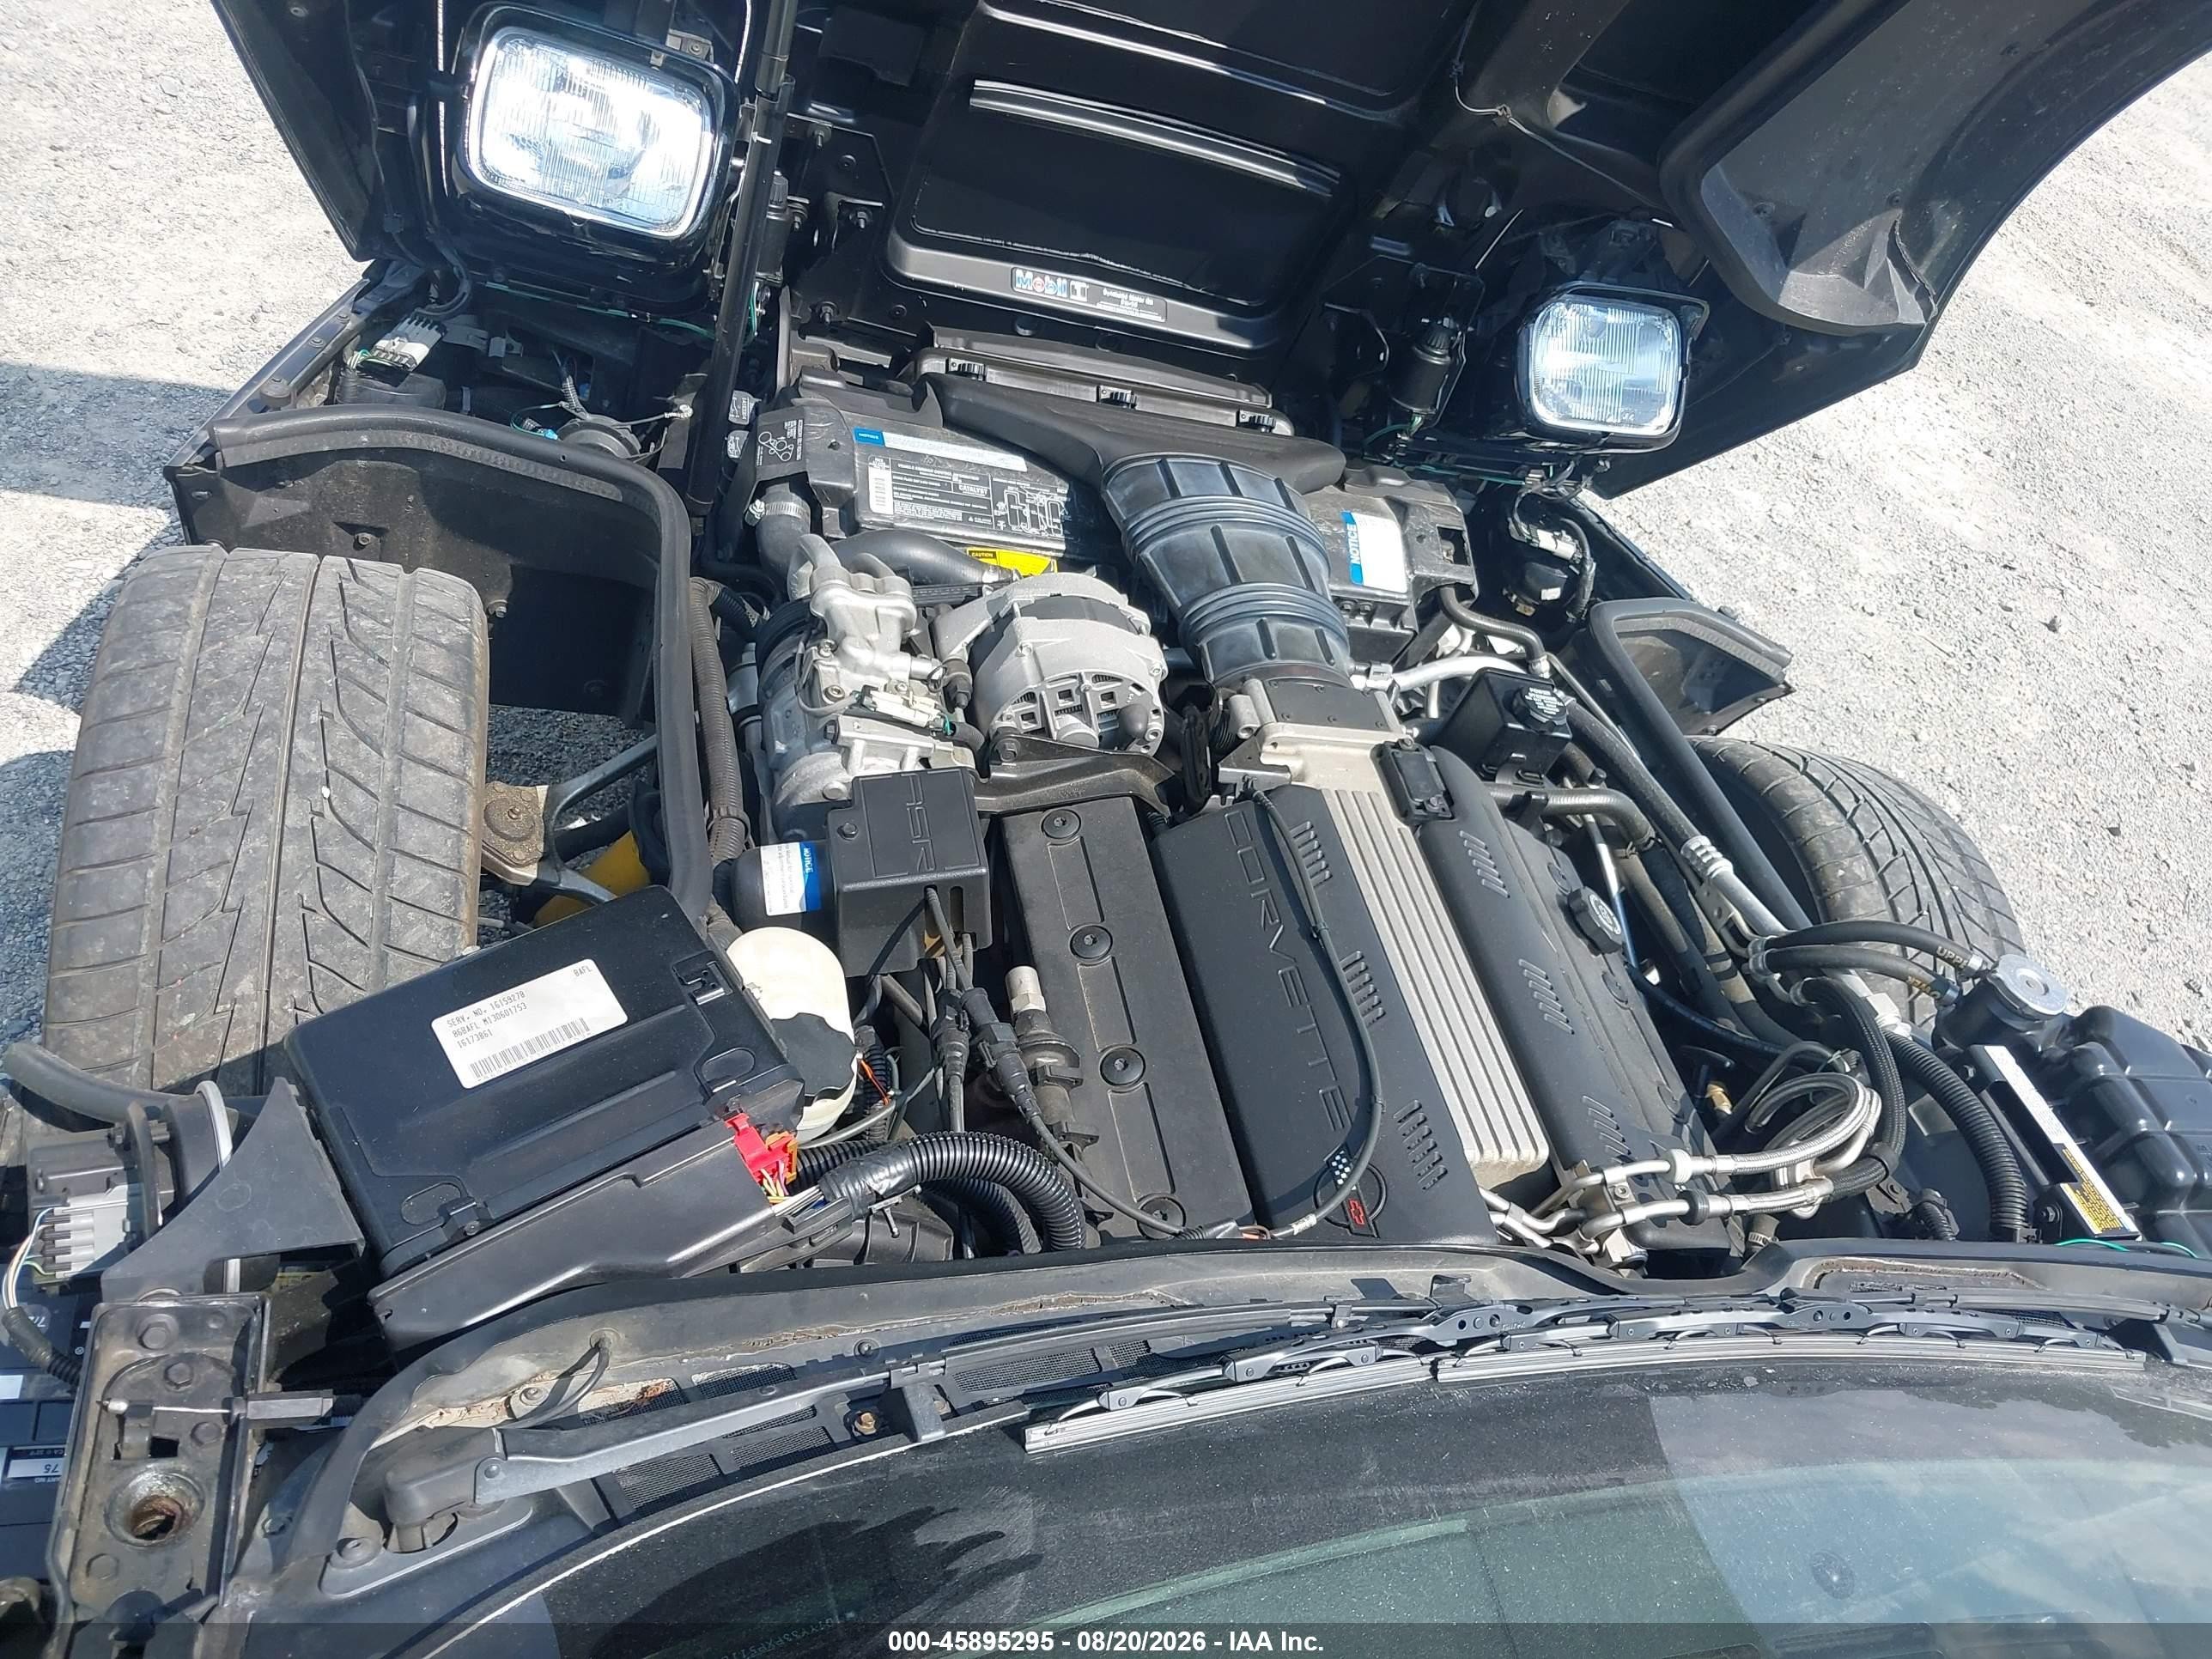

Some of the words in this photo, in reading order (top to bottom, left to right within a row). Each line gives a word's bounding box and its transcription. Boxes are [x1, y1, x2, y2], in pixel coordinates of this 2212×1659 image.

[1015, 269, 1068, 298] Mobil
[958, 484, 988, 495] CATALYST
[1346, 524, 1361, 565] NOTICE
[803, 848, 814, 874] NOTICE
[1936, 946, 1970, 969] UPPE
[574, 965, 592, 978] BAFL
[1224, 809, 1354, 1133] CORVETTE
[447, 1014, 471, 1029] SERV.
[472, 1006, 488, 1018] NO.
[43, 1463, 59, 1474] 75
